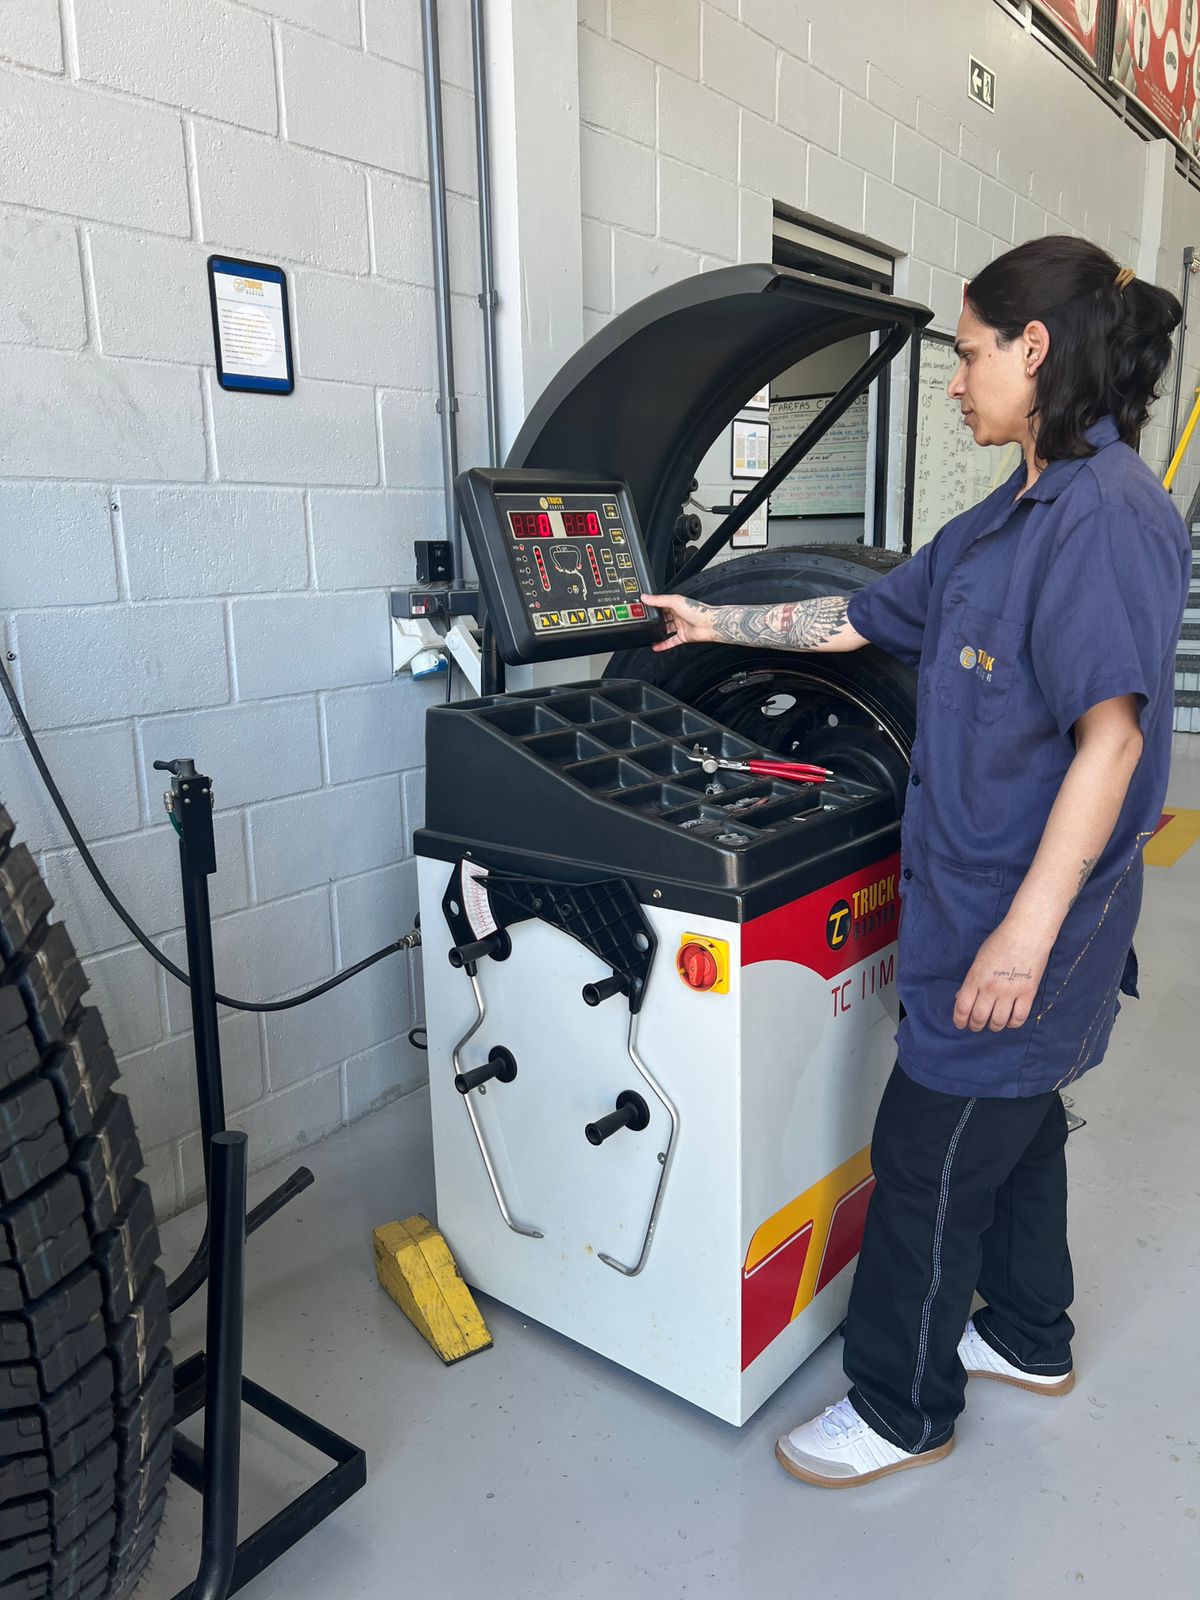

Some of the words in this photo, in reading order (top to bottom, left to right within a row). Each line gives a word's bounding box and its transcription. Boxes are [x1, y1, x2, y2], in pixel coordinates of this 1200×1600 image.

[771, 401, 810, 413] TAREFAS
[546, 496, 563, 504] TRUCK
[852, 874, 896, 919] TRUCK
[854, 904, 895, 940] CENTER
[831, 979, 852, 1017] TC
